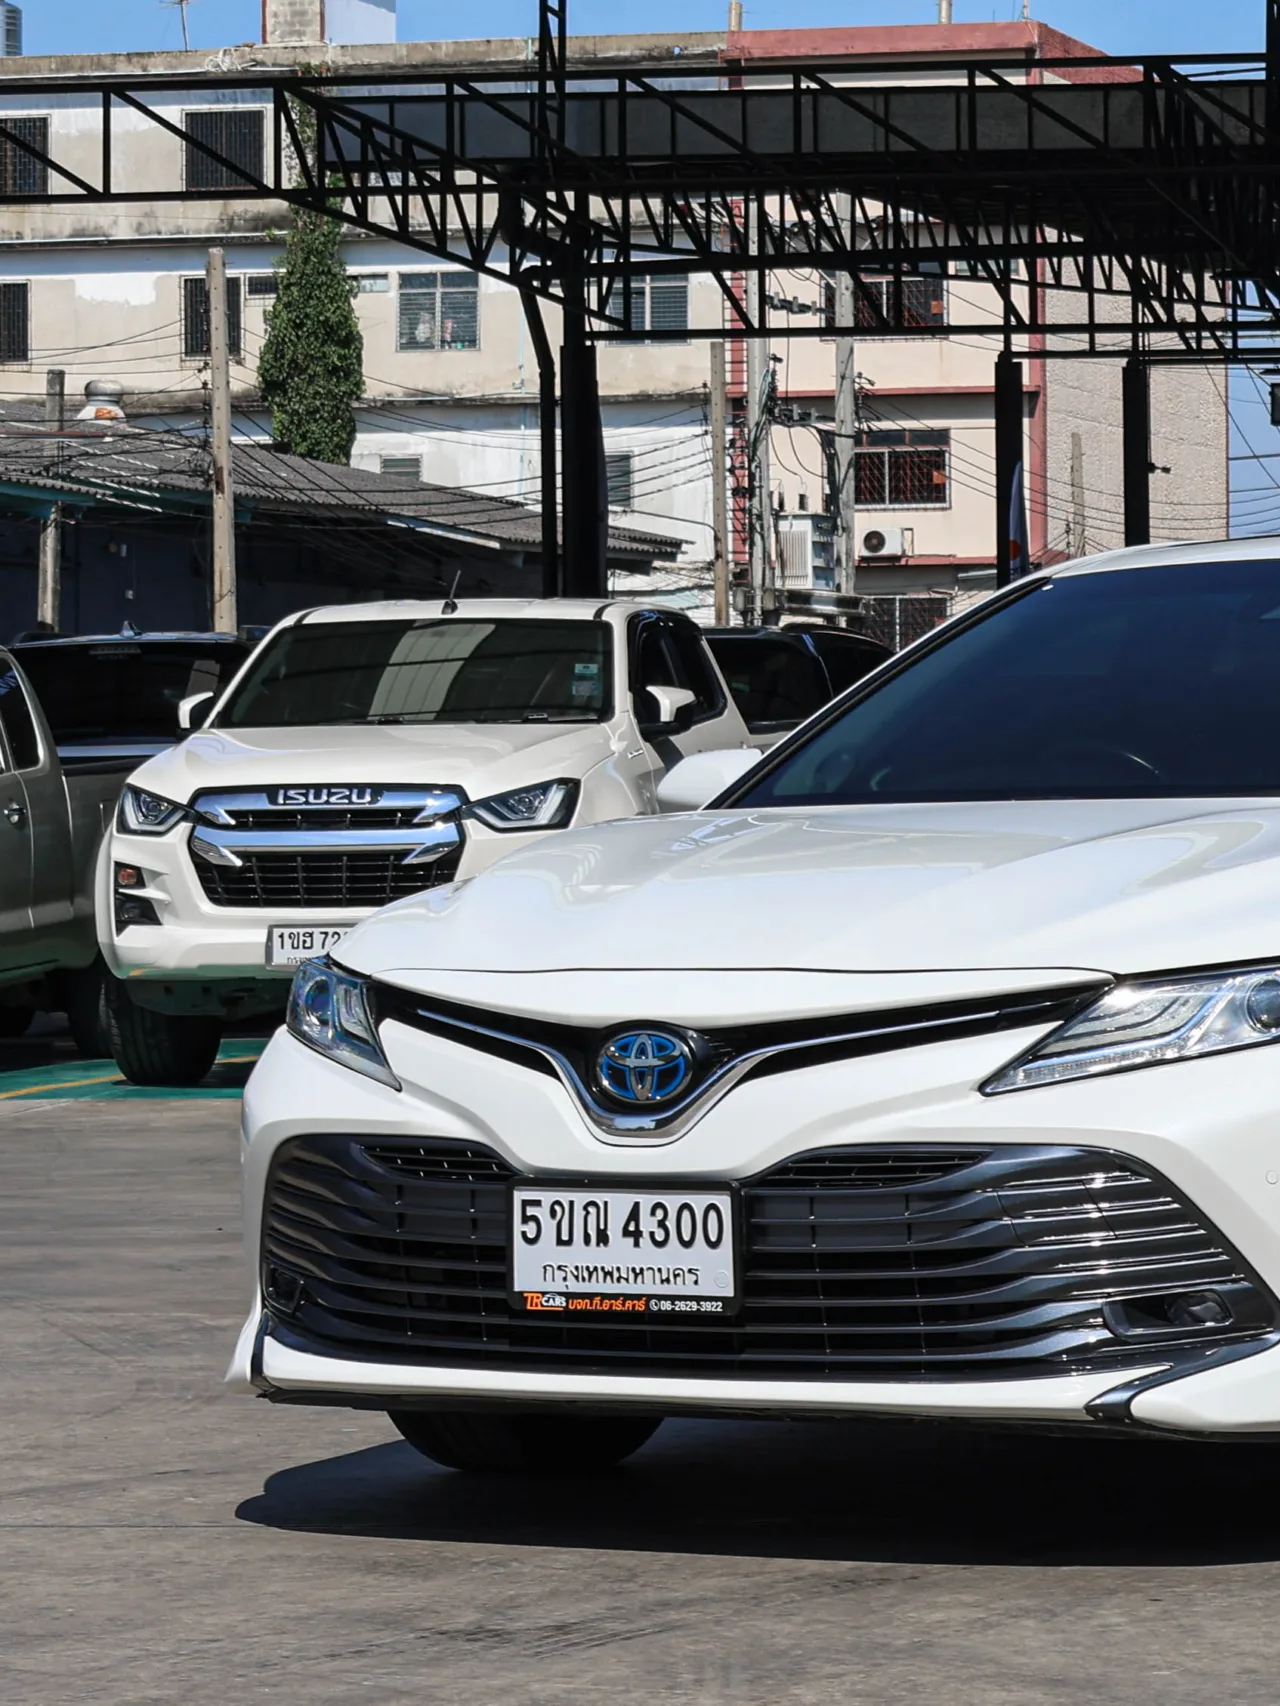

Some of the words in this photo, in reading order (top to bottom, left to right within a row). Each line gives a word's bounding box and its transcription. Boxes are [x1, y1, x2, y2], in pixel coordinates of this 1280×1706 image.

[277, 788, 371, 804] ISUZU
[319, 931, 348, 950] 72
[520, 1199, 610, 1248] 5ขณ
[622, 1201, 724, 1250] 4300
[542, 1263, 700, 1290] กรุงเทพมหานคร
[660, 1300, 723, 1312] 06-2629-3922
